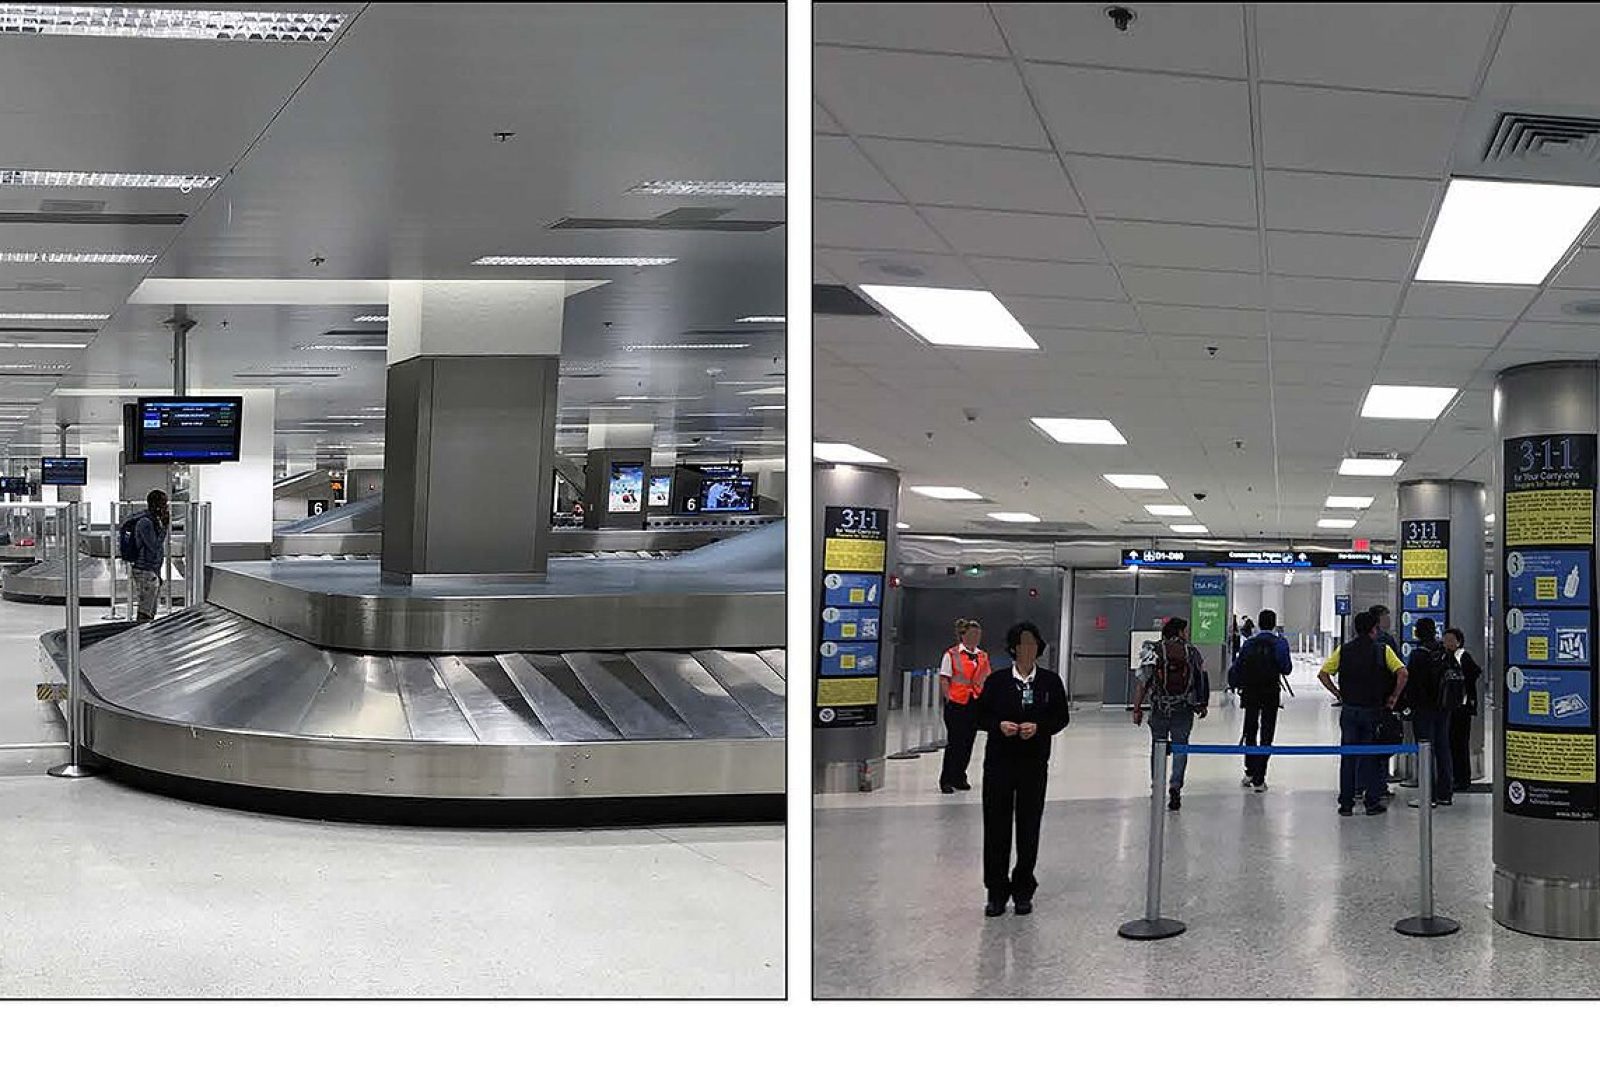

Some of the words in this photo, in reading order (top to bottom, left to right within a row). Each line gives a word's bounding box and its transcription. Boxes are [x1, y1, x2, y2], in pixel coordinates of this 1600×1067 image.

[1519, 438, 1573, 472] 3-1-1
[1540, 471, 1580, 481] Carry-ons
[314, 502, 323, 515] 6
[687, 499, 696, 511] 6
[841, 509, 877, 530] 3-1-1
[1511, 554, 1519, 575] 3
